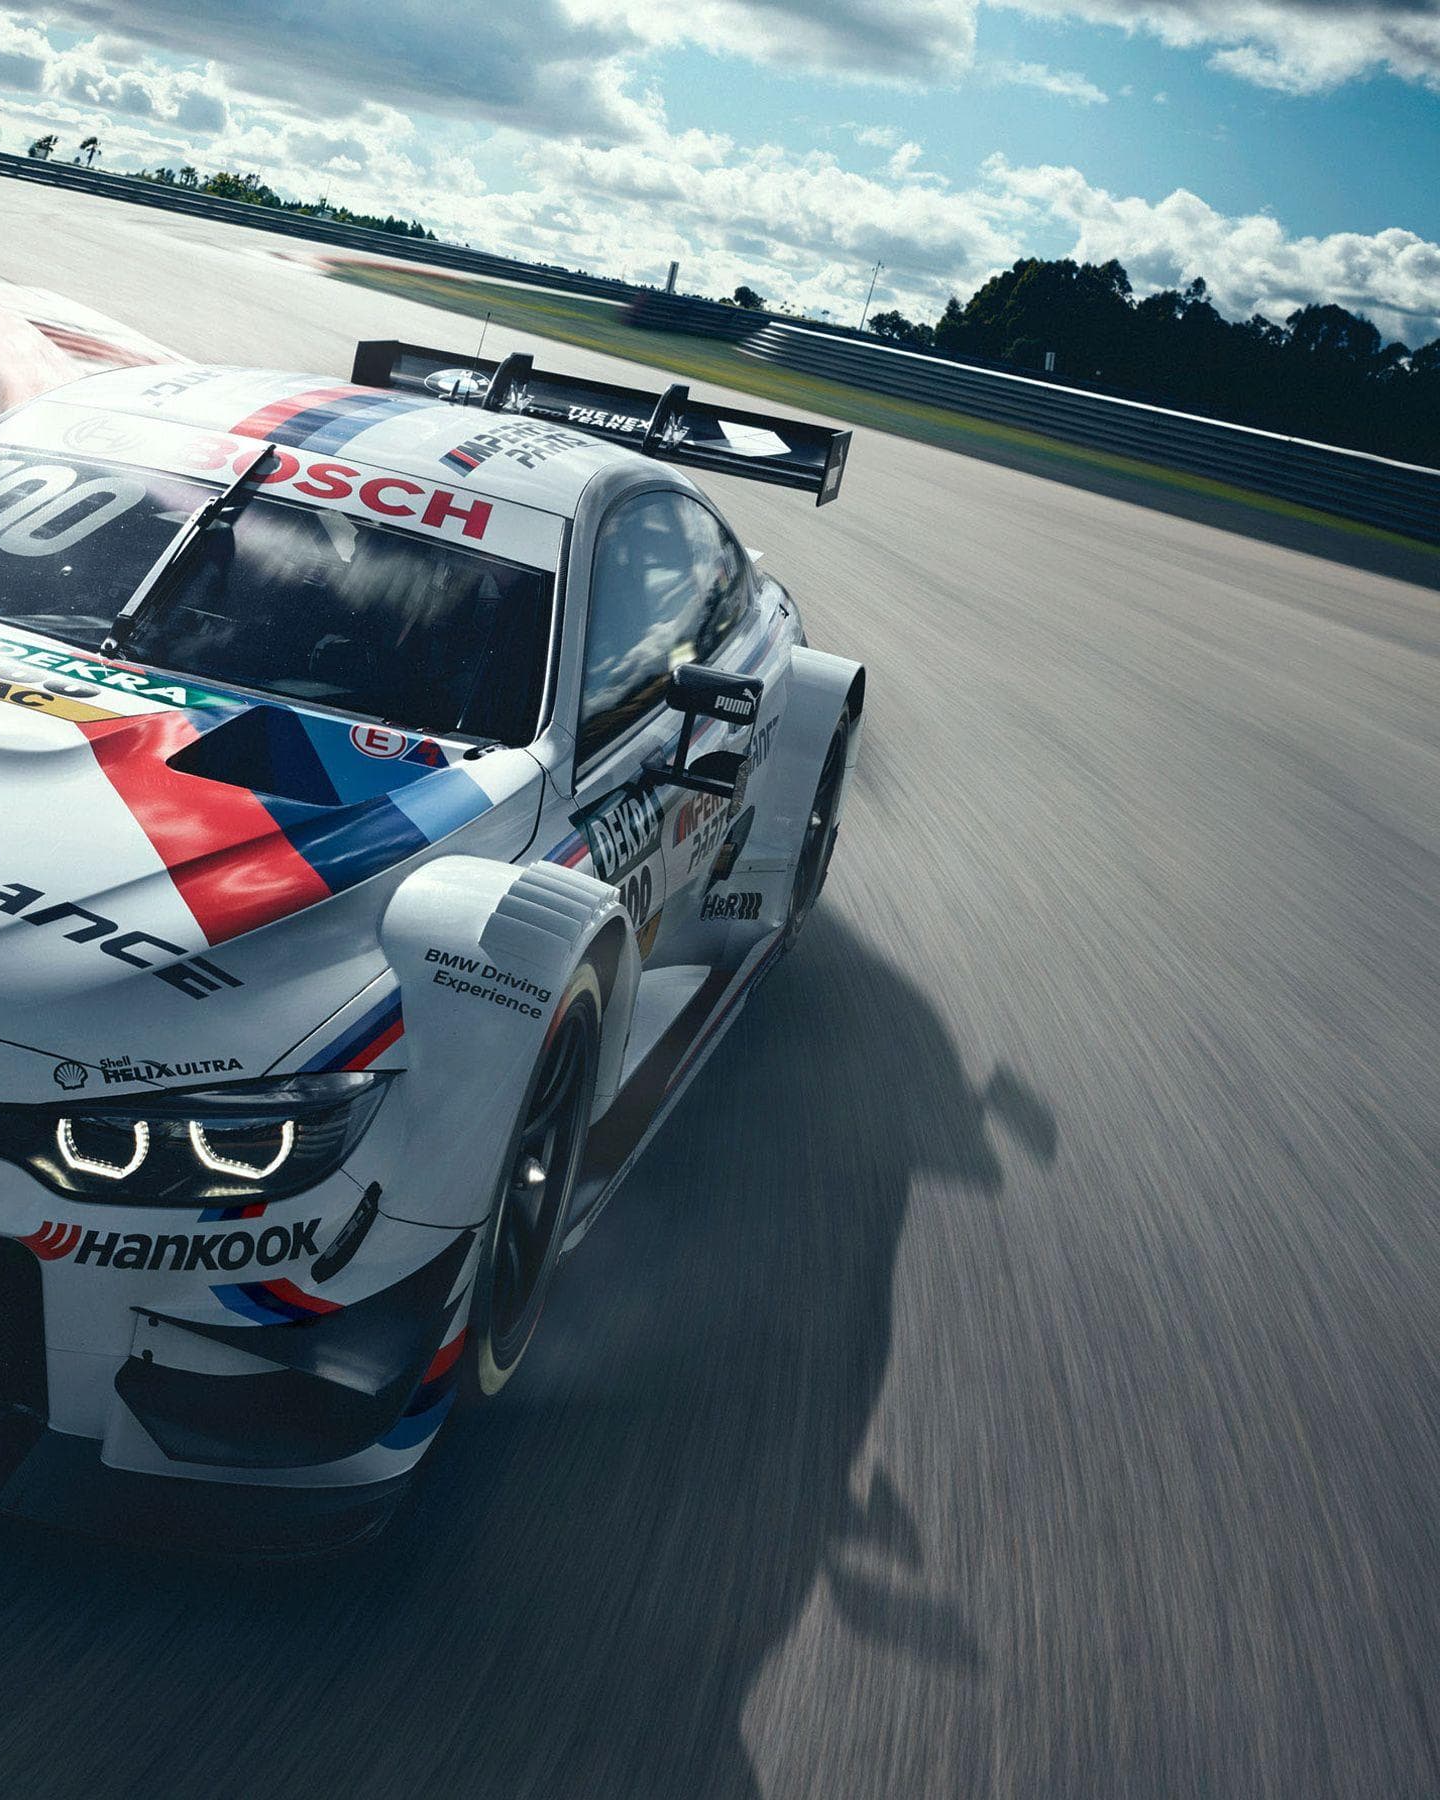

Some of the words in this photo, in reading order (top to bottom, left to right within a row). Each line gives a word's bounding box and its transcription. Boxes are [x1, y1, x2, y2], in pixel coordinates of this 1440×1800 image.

[569, 405, 608, 419] THE
[609, 414, 650, 430] NEX
[569, 413, 634, 432] YEARS
[184, 436, 493, 540] BOSCH
[714, 695, 753, 715] PUMA
[590, 790, 660, 878] DEKRA
[424, 948, 480, 973] BMW
[481, 964, 552, 1003] Driving
[433, 969, 543, 1019] Experience
[99, 1055, 131, 1069] Shell
[175, 1058, 244, 1076] ULTRA
